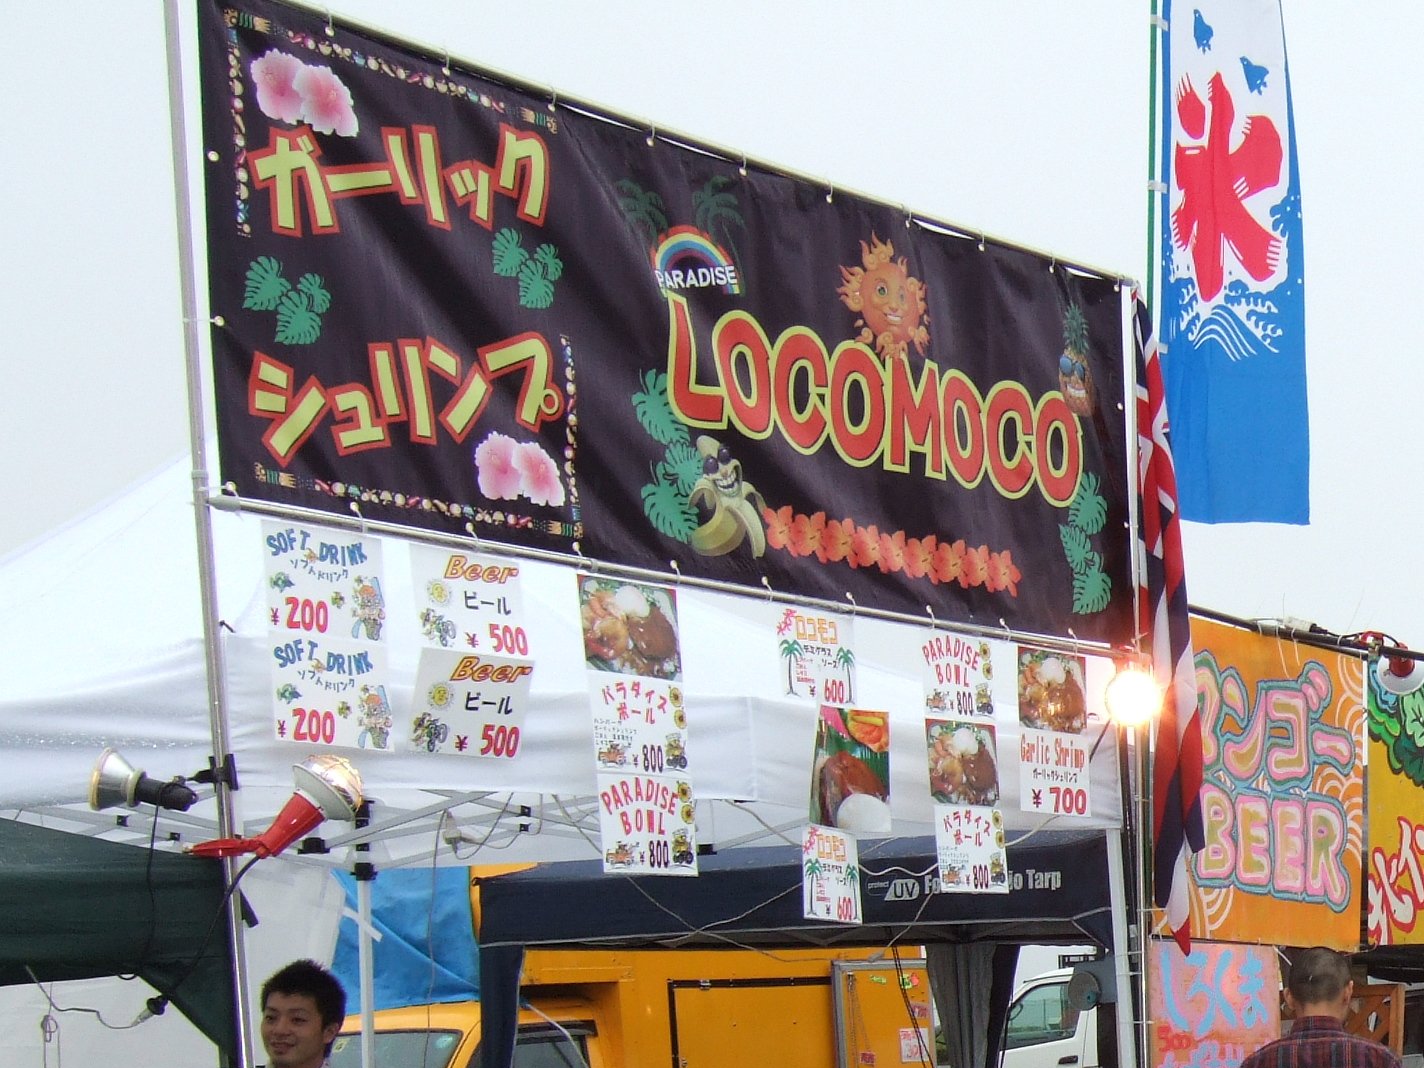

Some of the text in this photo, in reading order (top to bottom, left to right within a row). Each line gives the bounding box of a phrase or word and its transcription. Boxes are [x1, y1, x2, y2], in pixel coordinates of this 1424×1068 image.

[246, 125, 551, 237] ガーリック
[1174, 70, 1284, 303] 氷
[655, 265, 738, 290] PARADISE
[249, 332, 564, 466] シュリンプ
[666, 288, 1084, 508] LOCOMOCO
[266, 528, 367, 567] SOFT DRINK
[290, 559, 349, 583] ソフトドリンク
[444, 555, 519, 584] Beer
[464, 590, 512, 615] ビール
[795, 615, 838, 645] ロコモコ
[274, 638, 373, 676] SOFT DRINK
[922, 635, 981, 666] PARADISE
[297, 669, 355, 693] ソフトドリンク
[450, 656, 533, 683] Beer
[935, 663, 969, 687] BOWL
[465, 692, 513, 715] ビール
[1020, 733, 1086, 772] Garlic Shrimp
[600, 776, 680, 815] PARADISE
[620, 808, 666, 836] BOWL
[1194, 783, 1349, 912] BEER
[893, 881, 916, 899] UV
[1025, 869, 1061, 891] Tarp
[1160, 948, 1269, 1039] しろくま
